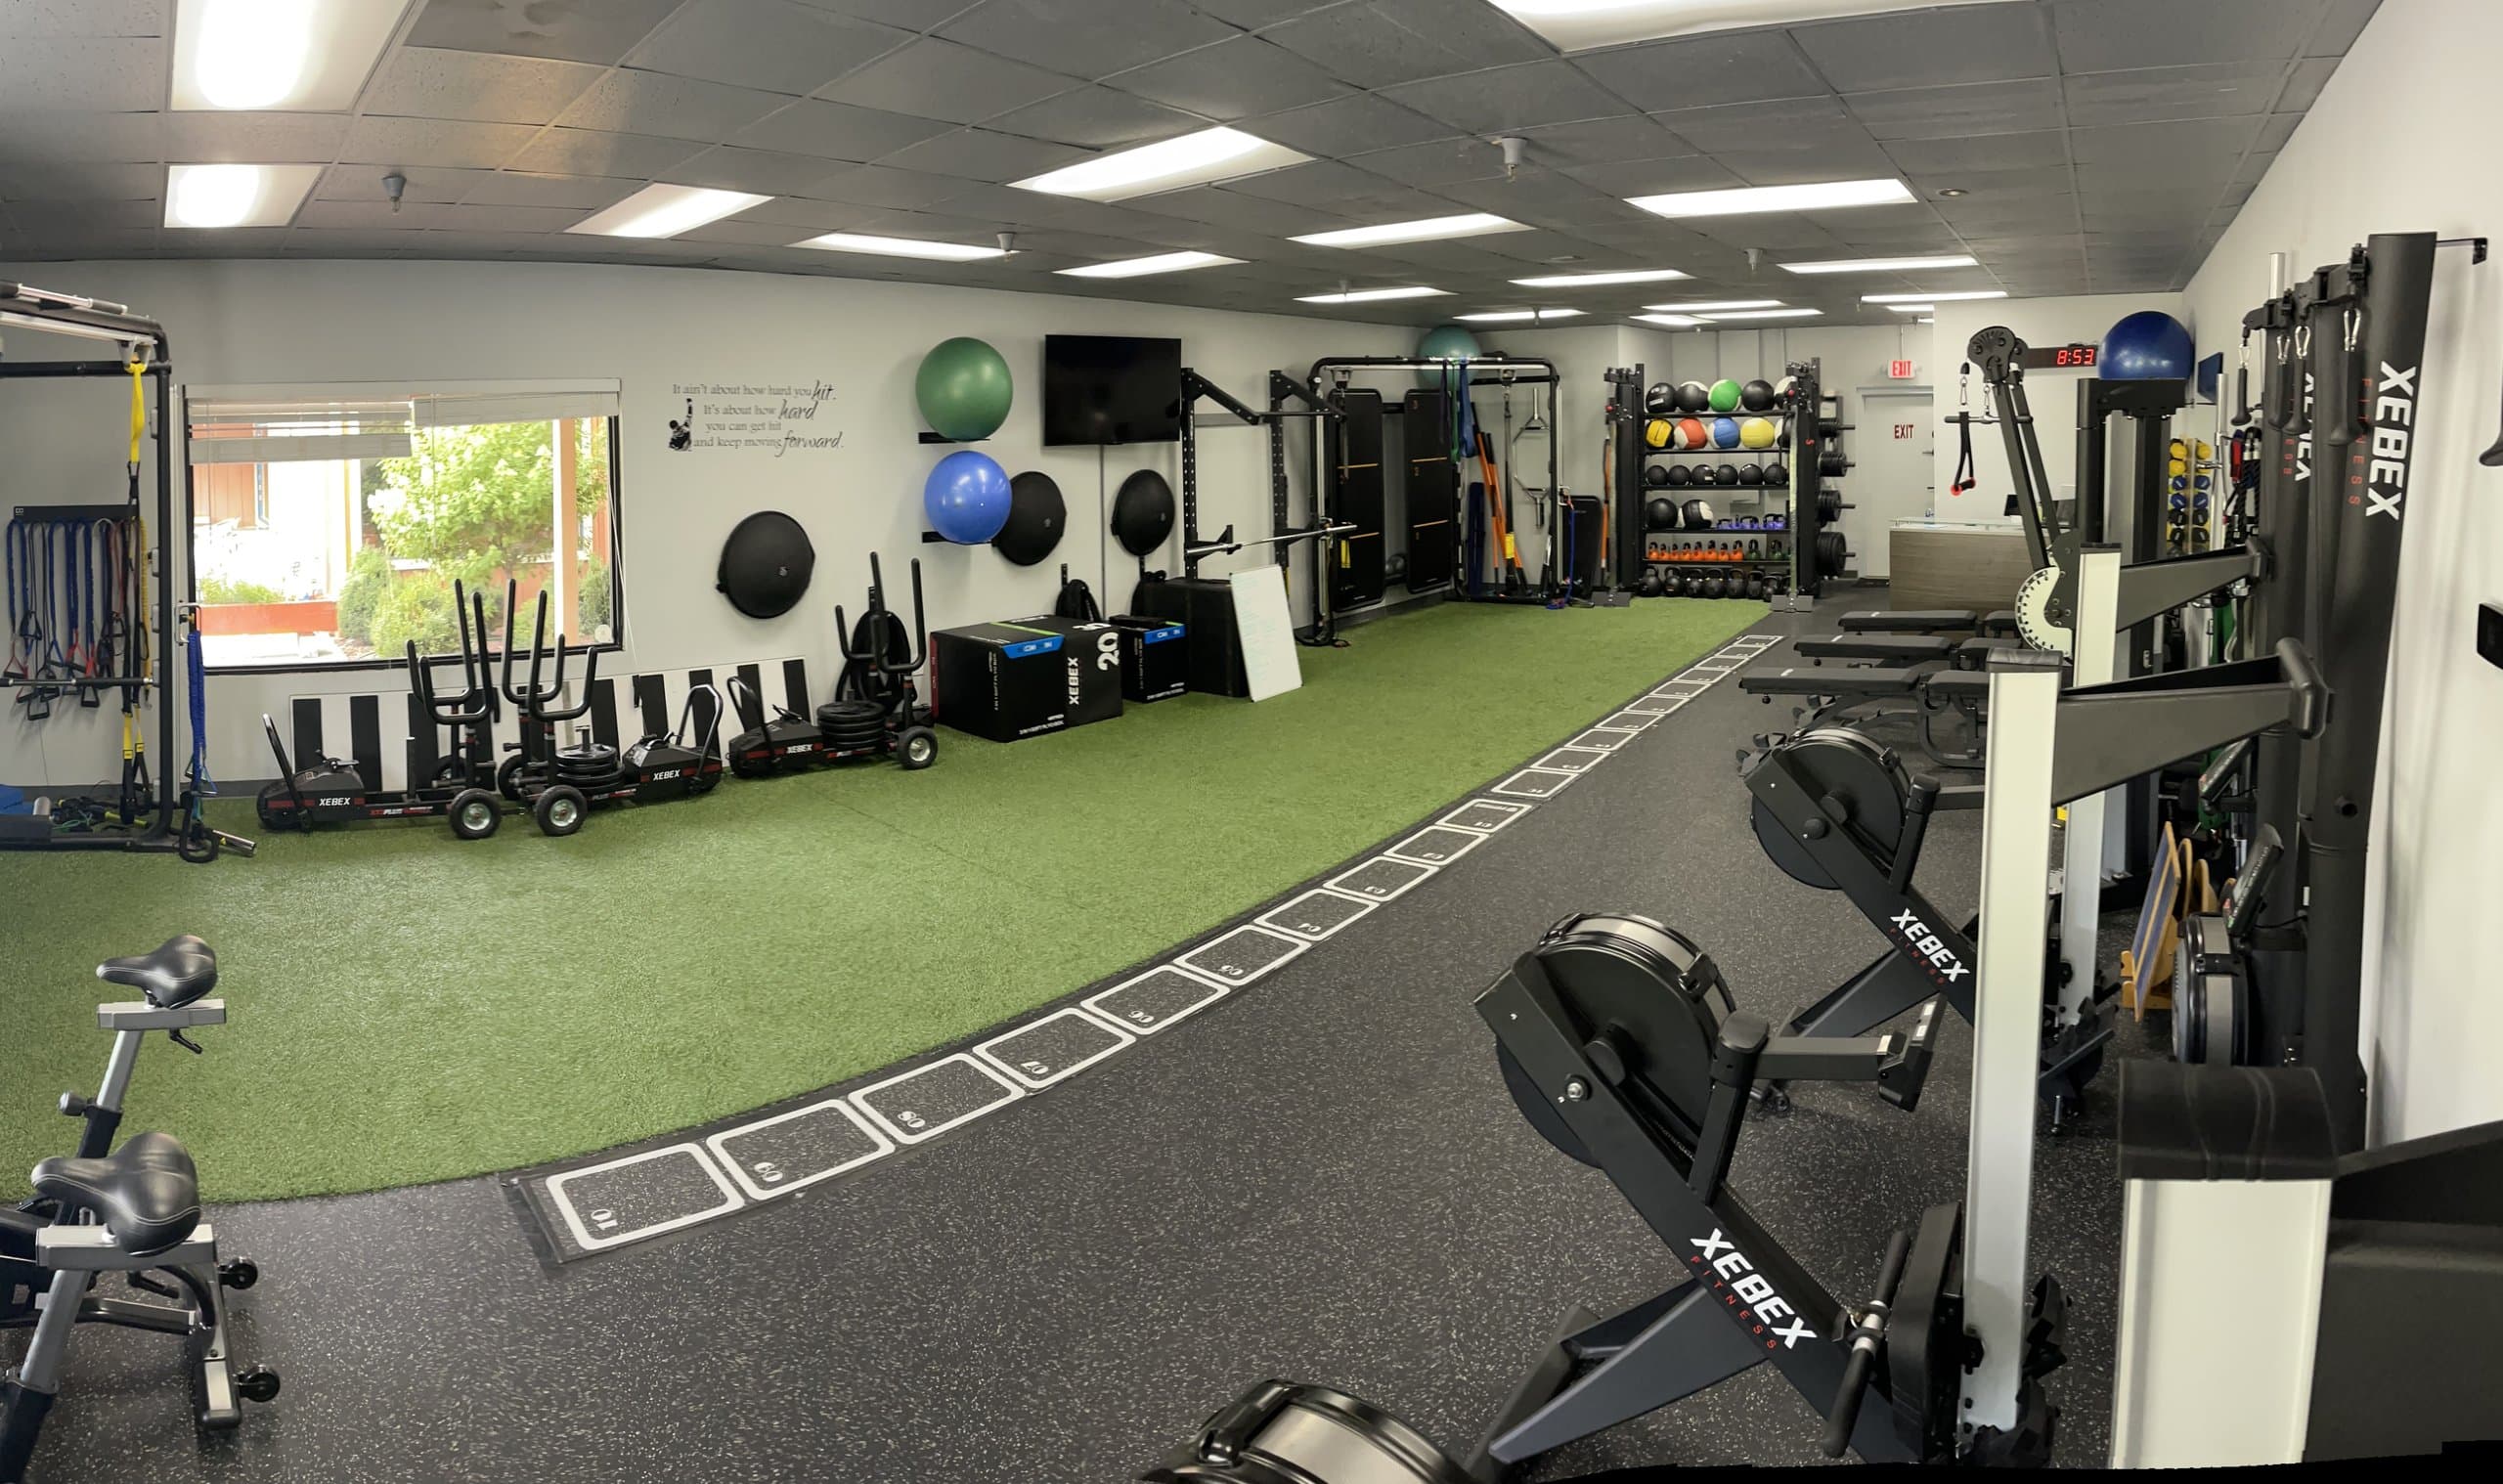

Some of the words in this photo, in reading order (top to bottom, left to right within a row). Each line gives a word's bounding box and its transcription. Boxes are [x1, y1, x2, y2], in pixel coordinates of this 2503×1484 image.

[1892, 360, 1912, 376] EXIT
[2056, 348, 2094, 367] 8:53
[673, 384, 681, 395] It
[682, 384, 708, 395] ain't
[711, 384, 740, 395] about
[743, 385, 767, 396] how
[768, 385, 791, 396] hard
[794, 388, 812, 399] you
[812, 379, 837, 401] hit.
[704, 404, 720, 415] It's
[723, 405, 752, 415] about
[755, 405, 777, 415] how
[778, 399, 818, 420] hard
[705, 422, 725, 434] you
[728, 422, 748, 431] can
[751, 421, 766, 434] get
[768, 421, 781, 431] hit
[1894, 424, 1914, 440] EXIT
[693, 436, 714, 447] and
[718, 436, 742, 450] keep
[744, 437, 782, 449] moving
[774, 429, 844, 458] forward.
[2365, 361, 2417, 521] XEBEX
[1097, 632, 1120, 671] 20
[1068, 656, 1079, 706] XEBEX
[786, 744, 812, 755] XEBEX
[653, 769, 681, 781] XEBEX
[319, 797, 351, 807] XEBEX
[1889, 907, 1970, 982] XEBEX
[1021, 1061, 1049, 1075] 07
[898, 1111, 926, 1128] 08
[754, 1161, 783, 1183] 09
[591, 1208, 618, 1231] 10
[1690, 1227, 1818, 1349] XEBEX
[1690, 1255, 1777, 1349] FITNESS
